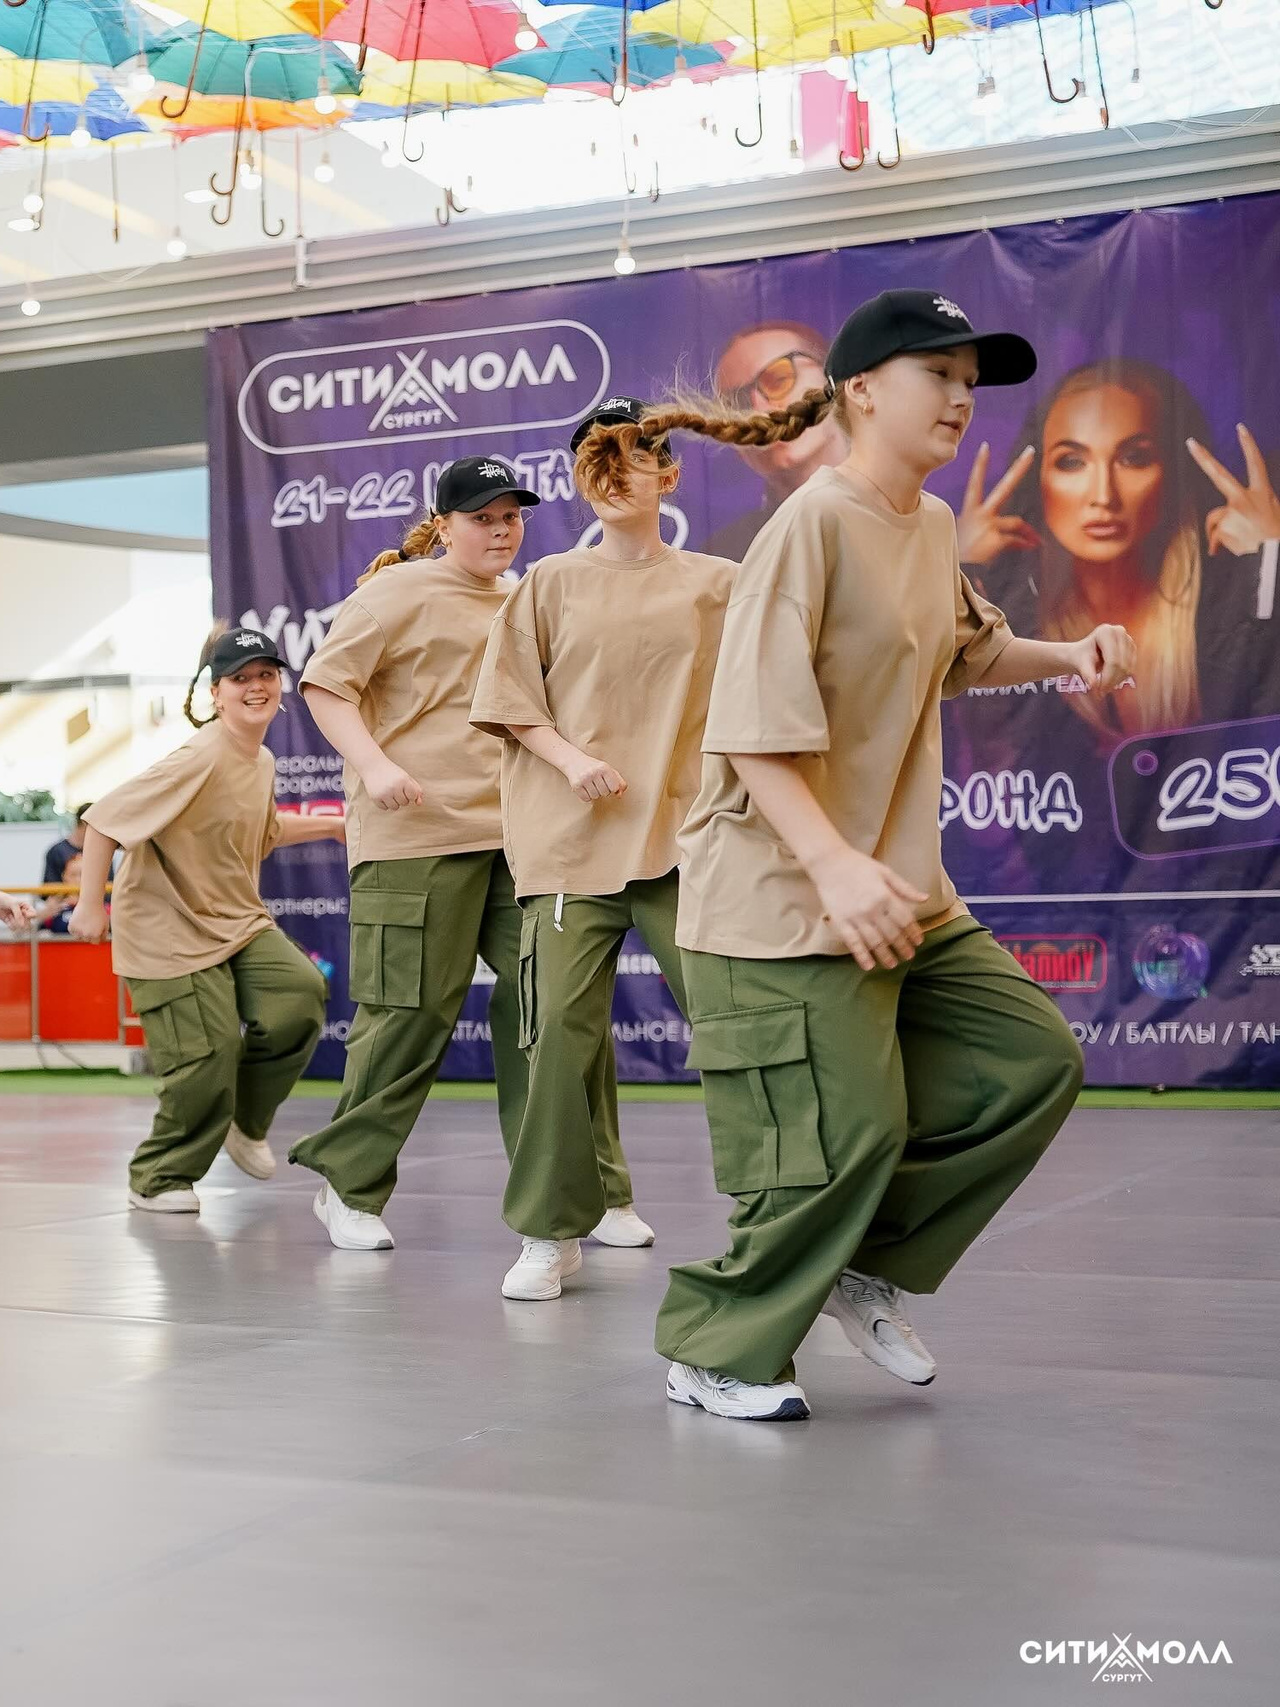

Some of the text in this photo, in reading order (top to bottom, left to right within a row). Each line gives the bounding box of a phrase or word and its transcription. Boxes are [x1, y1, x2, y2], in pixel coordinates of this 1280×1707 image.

[269, 343, 578, 414] СИТИ МОЛЛ
[382, 408, 444, 430] СУРГУТ
[271, 469, 418, 528] 21-22
